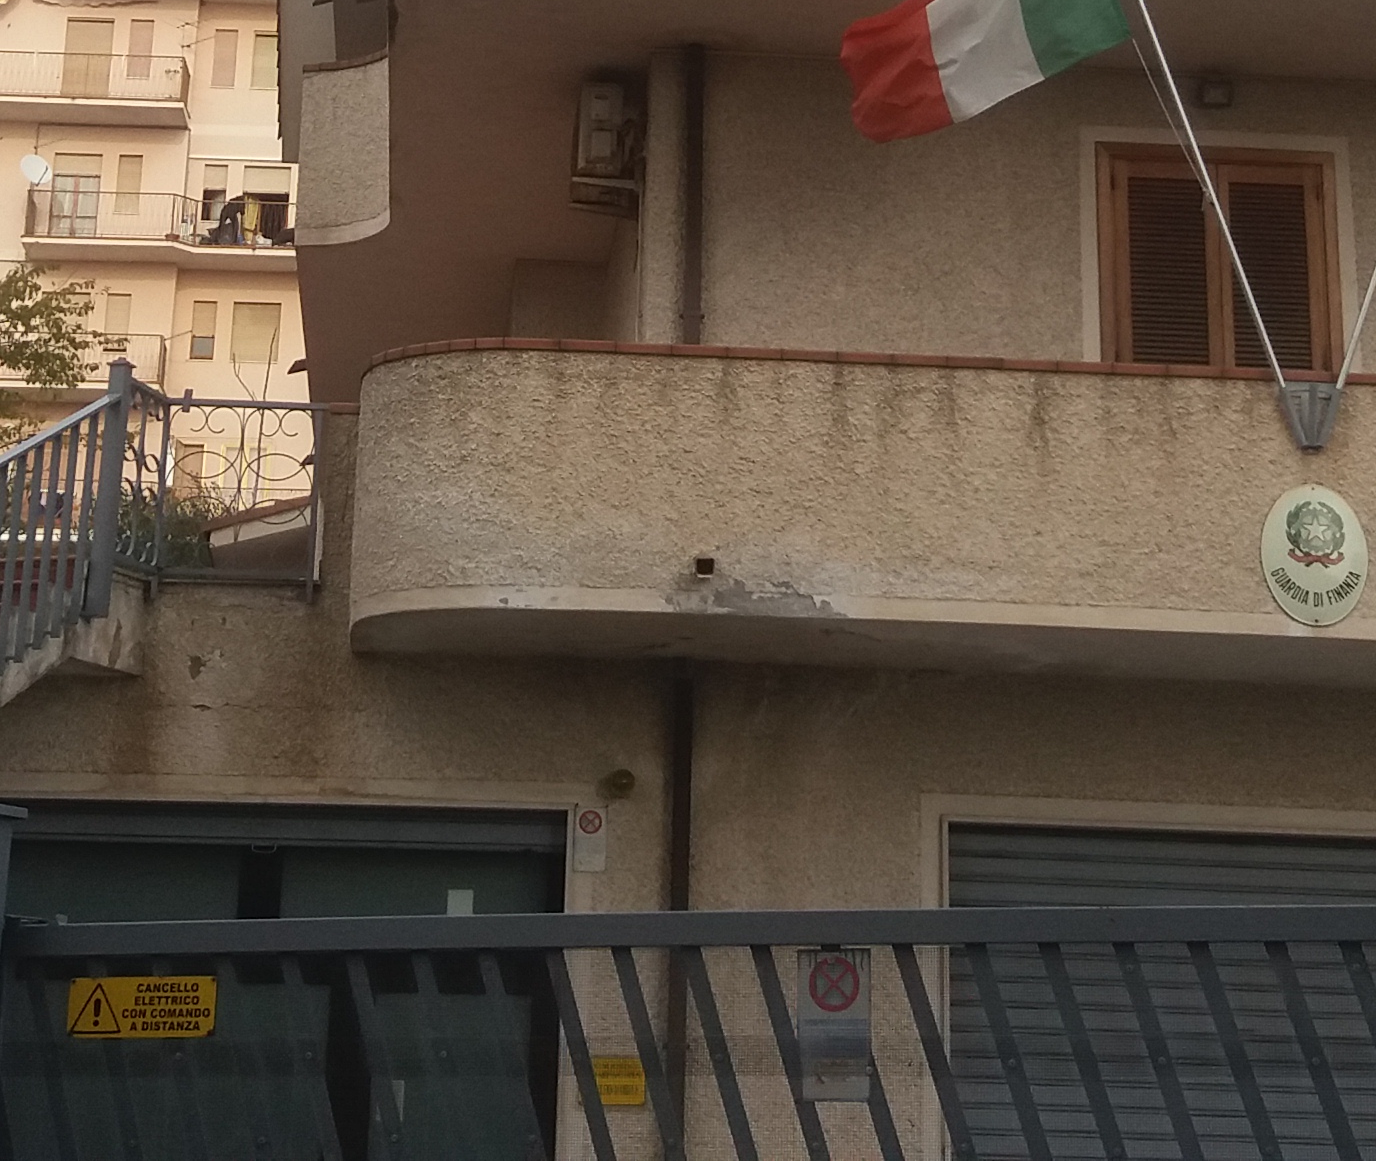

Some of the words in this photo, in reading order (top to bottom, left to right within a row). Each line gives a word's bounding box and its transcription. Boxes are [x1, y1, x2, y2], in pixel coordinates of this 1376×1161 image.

[1270, 567, 1310, 605] GUARDIA
[1313, 591, 1324, 607] DI
[1325, 571, 1362, 605] FINANZA
[136, 982, 200, 993] CANCELLO
[134, 995, 200, 1006] ELETTRICO
[121, 1008, 147, 1019] CON
[150, 1008, 211, 1019] COMANDO
[129, 1021, 138, 1031] A
[141, 1020, 201, 1031] DISTANZA
